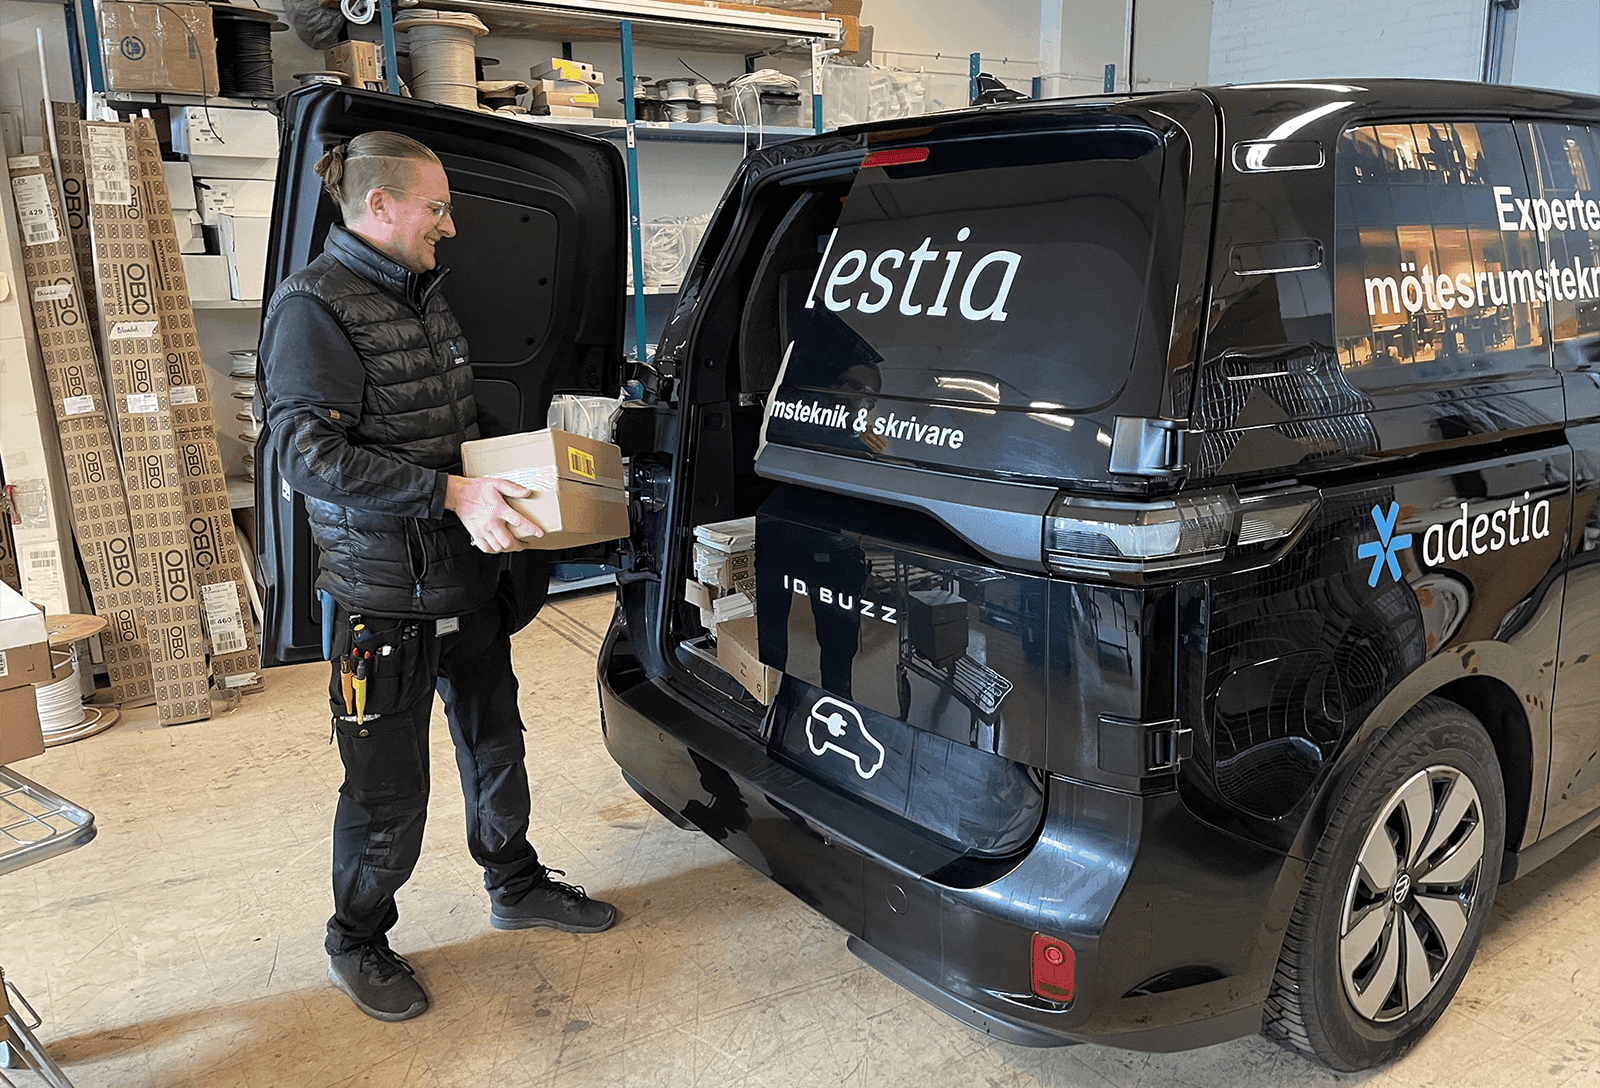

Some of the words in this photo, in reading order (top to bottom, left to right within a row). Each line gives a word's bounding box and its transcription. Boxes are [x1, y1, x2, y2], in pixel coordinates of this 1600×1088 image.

[28, 208, 43, 216] 429
[63, 178, 84, 229] OBO
[1492, 185, 1600, 243] Experte
[112, 263, 124, 316] BETTERMANN
[126, 263, 150, 316] OBO
[67, 365, 84, 397] OBO
[134, 359, 149, 393] OBO
[166, 352, 183, 386] OBO
[852, 407, 868, 433] &
[872, 412, 964, 450] skrivare
[85, 451, 102, 483] OBO
[146, 454, 162, 489] OBO
[185, 444, 202, 477] OBO
[189, 517, 214, 570] OBO
[214, 515, 227, 564] BETTERMANN
[1422, 490, 1550, 567] adestia
[95, 541, 109, 590] BETTERMANN
[108, 537, 134, 587] OBO
[150, 552, 163, 604] BETTERMANN
[164, 549, 189, 602] OBO
[118, 609, 135, 642] OBO
[217, 616, 232, 625] 460
[819, 586, 898, 625] BUZZ
[169, 626, 185, 660] OBO
